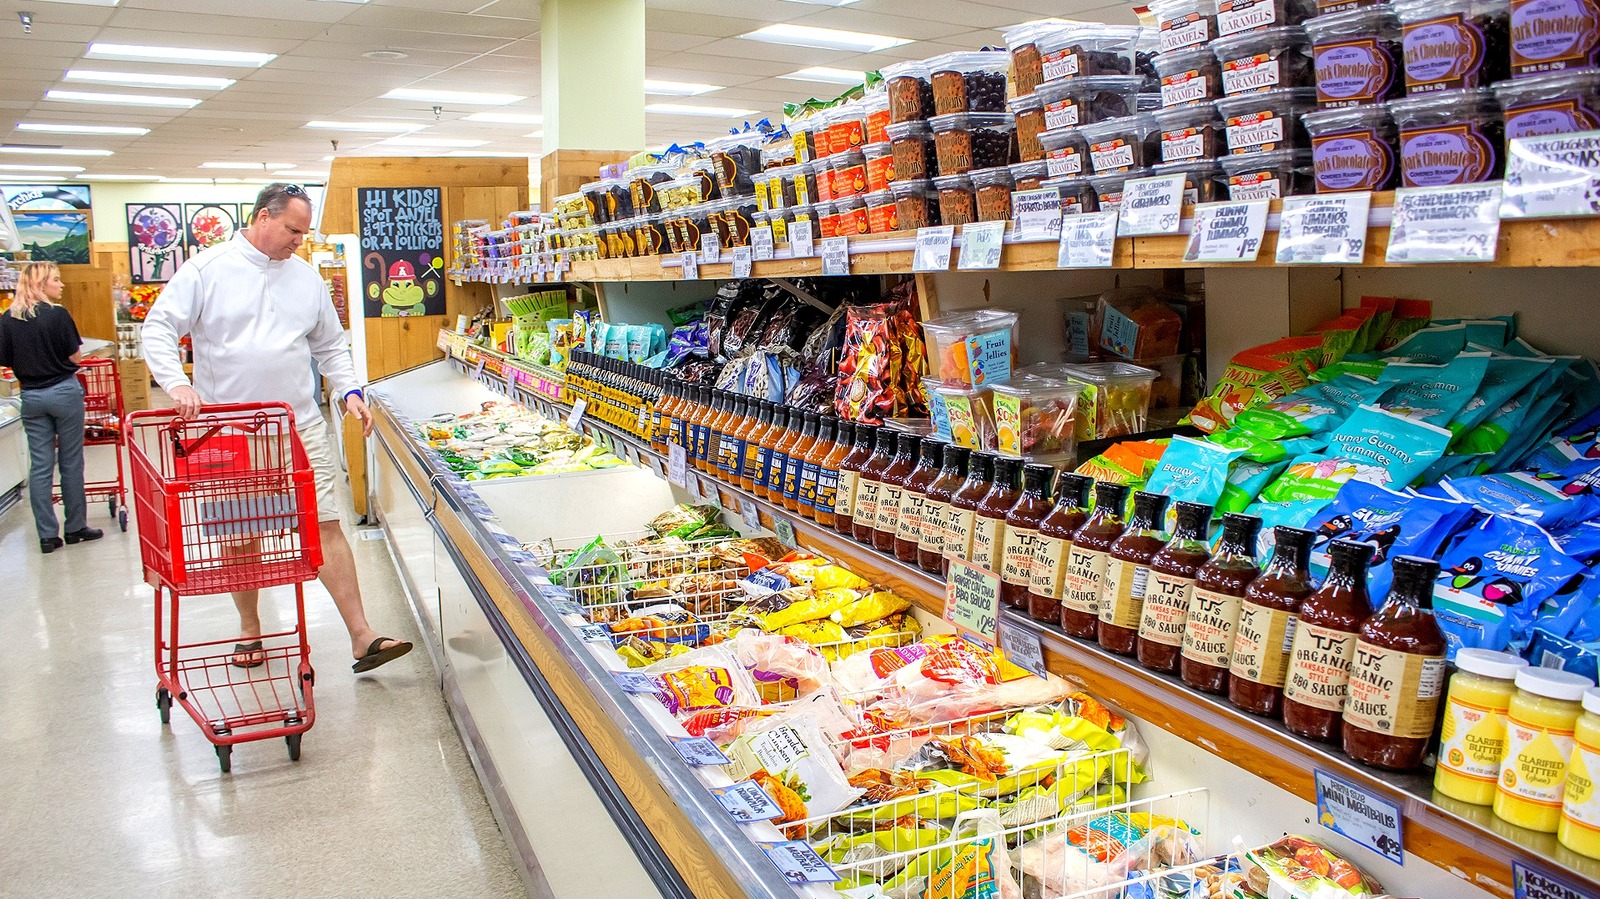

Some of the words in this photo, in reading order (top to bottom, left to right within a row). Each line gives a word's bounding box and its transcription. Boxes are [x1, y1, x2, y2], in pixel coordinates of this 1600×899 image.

[366, 190, 386, 208] HI
[393, 189, 438, 208] KIDS!
[364, 208, 392, 222] SPOT
[395, 206, 438, 222] ANGEL
[364, 223, 371, 236] &
[373, 222, 394, 236] GET
[397, 222, 442, 236] STICKERS
[362, 236, 379, 250] OR
[381, 236, 392, 250] A
[395, 236, 442, 250] LOLLIPOP
[986, 339, 1005, 349] Fruit
[985, 351, 1007, 361] Jellies
[1341, 444, 1391, 466] Tummies
[1368, 435, 1414, 464] Gummy
[964, 567, 985, 584] ORGANIC
[956, 586, 969, 604] BBQ
[1071, 591, 1096, 601] SAUCE
[1150, 605, 1170, 614] KANSAS
[1156, 613, 1173, 622] STYLE
[1194, 632, 1209, 641] STYLE
[1207, 628, 1221, 636] CITY
[1196, 640, 1226, 653] SAUCE
[1297, 650, 1352, 672] ORGANIC
[1300, 661, 1325, 674] KANSAS
[1327, 667, 1343, 677] CITY
[1292, 673, 1309, 690] BBQ
[1312, 682, 1348, 696] SAUCE
[1309, 672, 1329, 684] STYLE
[1352, 690, 1369, 702] STYLE
[1366, 685, 1382, 696] CITY
[1353, 699, 1388, 716] SAUCE
[767, 730, 790, 764] Chicken
[778, 726, 805, 757] Breaded
[1465, 734, 1504, 747] CLARIFIE
[1469, 743, 1502, 755] BUTTER
[1518, 754, 1564, 770] CLARIFIED
[1521, 763, 1558, 778] BUTTER
[1322, 785, 1344, 805] MINI
